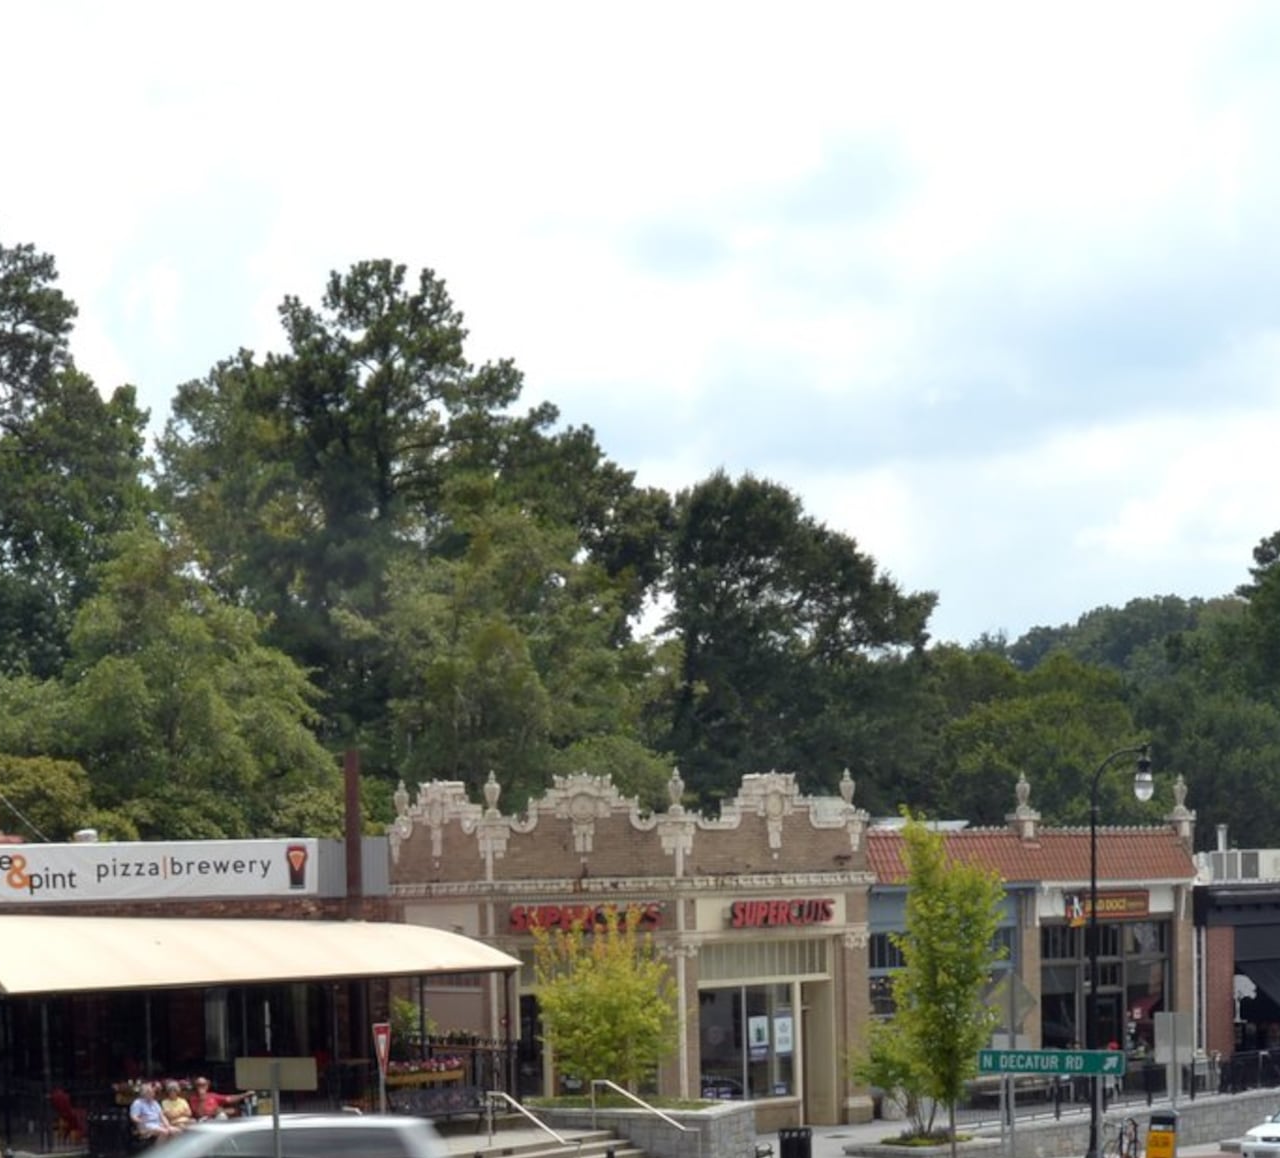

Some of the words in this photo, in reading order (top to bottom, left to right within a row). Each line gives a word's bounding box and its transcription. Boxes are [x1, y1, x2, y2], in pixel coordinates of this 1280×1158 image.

[28, 866, 77, 895] pint
[96, 858, 160, 883] pizza
[170, 856, 272, 878] brewery
[731, 898, 836, 928] SUPERCUTS
[982, 1054, 993, 1068] N
[1000, 1054, 1059, 1070] DECATUR
[1065, 1055, 1084, 1070] RD
